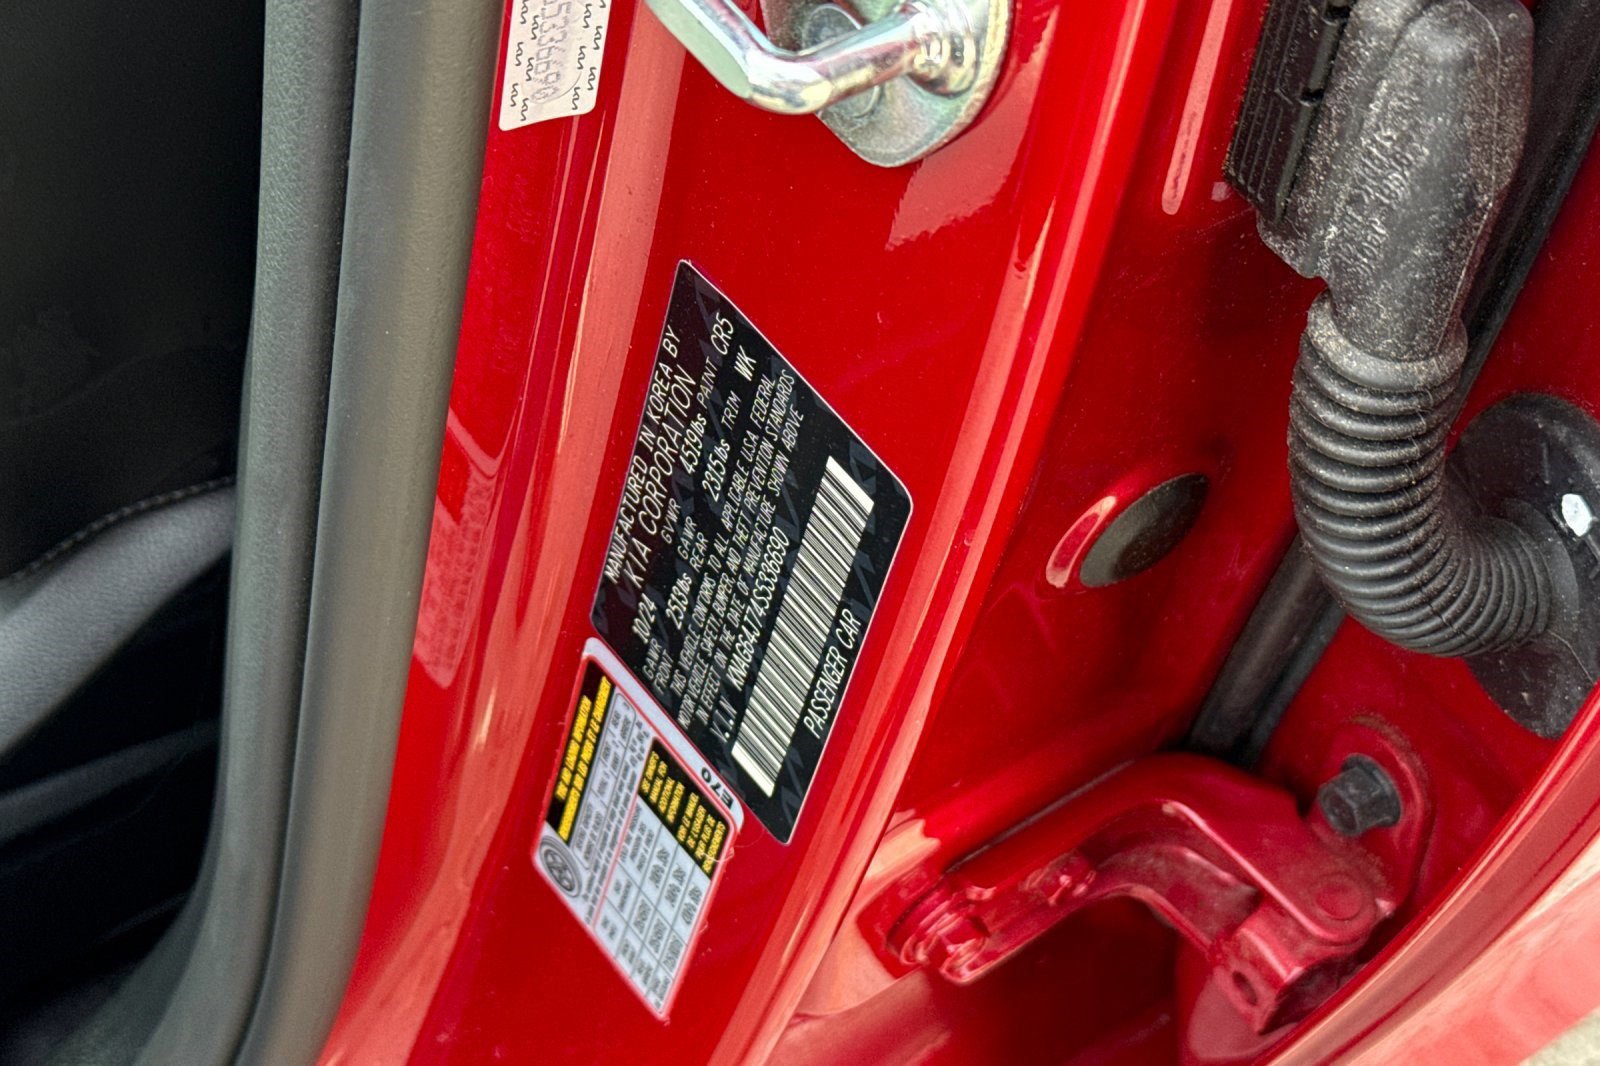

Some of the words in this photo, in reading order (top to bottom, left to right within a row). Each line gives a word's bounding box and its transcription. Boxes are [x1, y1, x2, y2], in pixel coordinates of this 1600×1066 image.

[662, 324, 680, 358] BY
[696, 355, 717, 409] PAINT
[710, 311, 734, 355] CR5
[646, 362, 673, 425] KOREA
[721, 390, 741, 430] TRIM
[734, 345, 756, 381] WK
[749, 374, 776, 429] FEDERAL
[764, 368, 795, 442] STANDARDS
[638, 424, 656, 452] IN
[780, 403, 804, 452] ABOVE
[623, 537, 652, 589] KIA
[638, 364, 696, 535] CORPORATION
[720, 459, 750, 532] APPLICABLE
[743, 436, 774, 514] PREVENTION
[767, 450, 790, 497] SHOWN
[604, 455, 648, 583] MANUFACTURED
[660, 497, 681, 544] GVWR
[677, 516, 697, 560] GAWR
[732, 509, 752, 550] THEFT
[742, 494, 776, 578] MANUFACTURE
[689, 531, 708, 573] REAR
[707, 554, 722, 573] TO
[713, 532, 730, 558] ALL
[726, 547, 742, 575] AND
[712, 572, 736, 618] BUMPER,
[736, 573, 750, 596] OF
[632, 592, 657, 644] 10/24
[726, 526, 790, 691] KNAG64J74S5336690
[726, 592, 746, 628] DATE
[678, 623, 701, 671] VEHICLE
[699, 613, 724, 657] SAFETY,
[719, 623, 736, 650] THE
[642, 637, 662, 680] GAWR
[653, 648, 673, 695] FRONT
[687, 652, 709, 699] VEHICLE
[713, 648, 728, 669] ON
[803, 645, 848, 739] PASSENGER
[835, 608, 861, 649] CAR
[669, 669, 687, 696] THIS
[700, 665, 721, 710] EFFECT
[677, 694, 695, 729] MOTOR
[695, 705, 709, 725] IN
[700, 767, 734, 810] E70
